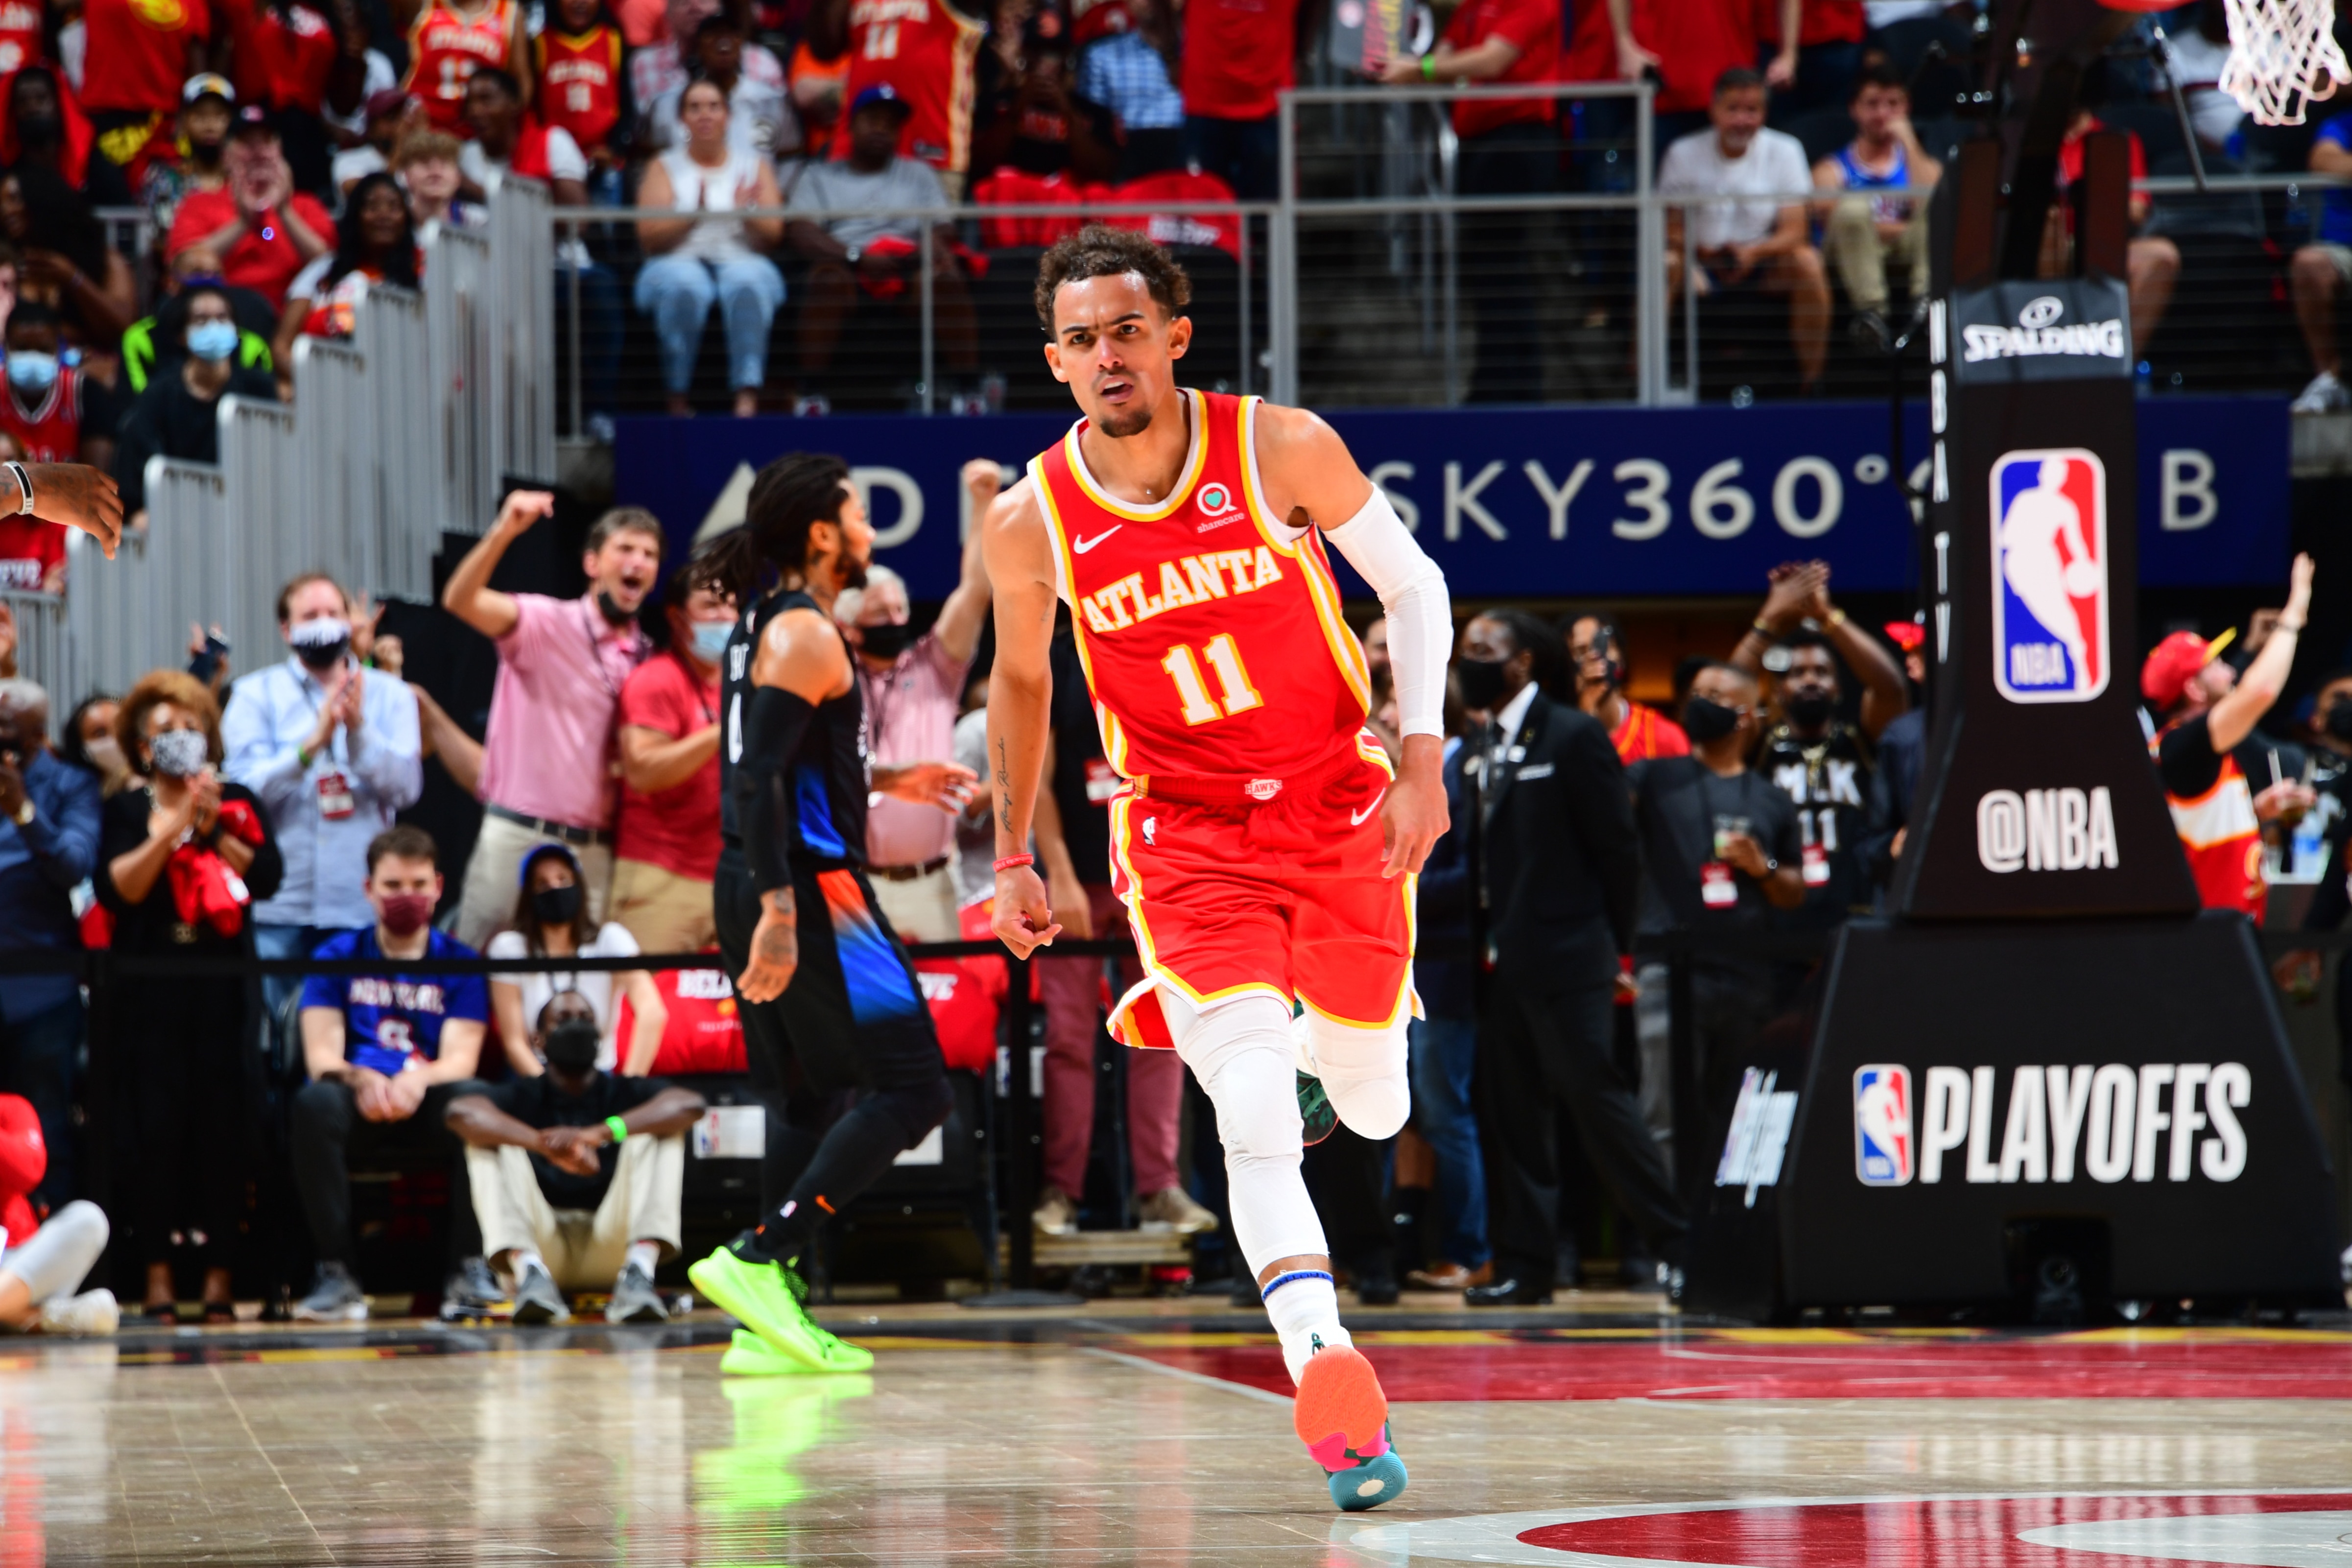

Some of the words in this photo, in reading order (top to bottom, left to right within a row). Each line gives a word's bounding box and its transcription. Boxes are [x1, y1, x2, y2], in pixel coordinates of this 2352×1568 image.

[1963, 318, 2124, 362] SPALDING
[1197, 512, 1245, 533] sharecare
[1081, 545, 1283, 633] ATLANTA
[1161, 633, 1264, 726] 11
[2011, 642, 2067, 685] NBA
[1244, 780, 1283, 794] HAWKS
[1797, 809, 1836, 850] 11
[1976, 786, 2119, 873] @NBA
[1919, 1062, 2252, 1184] PLAYOFFS
